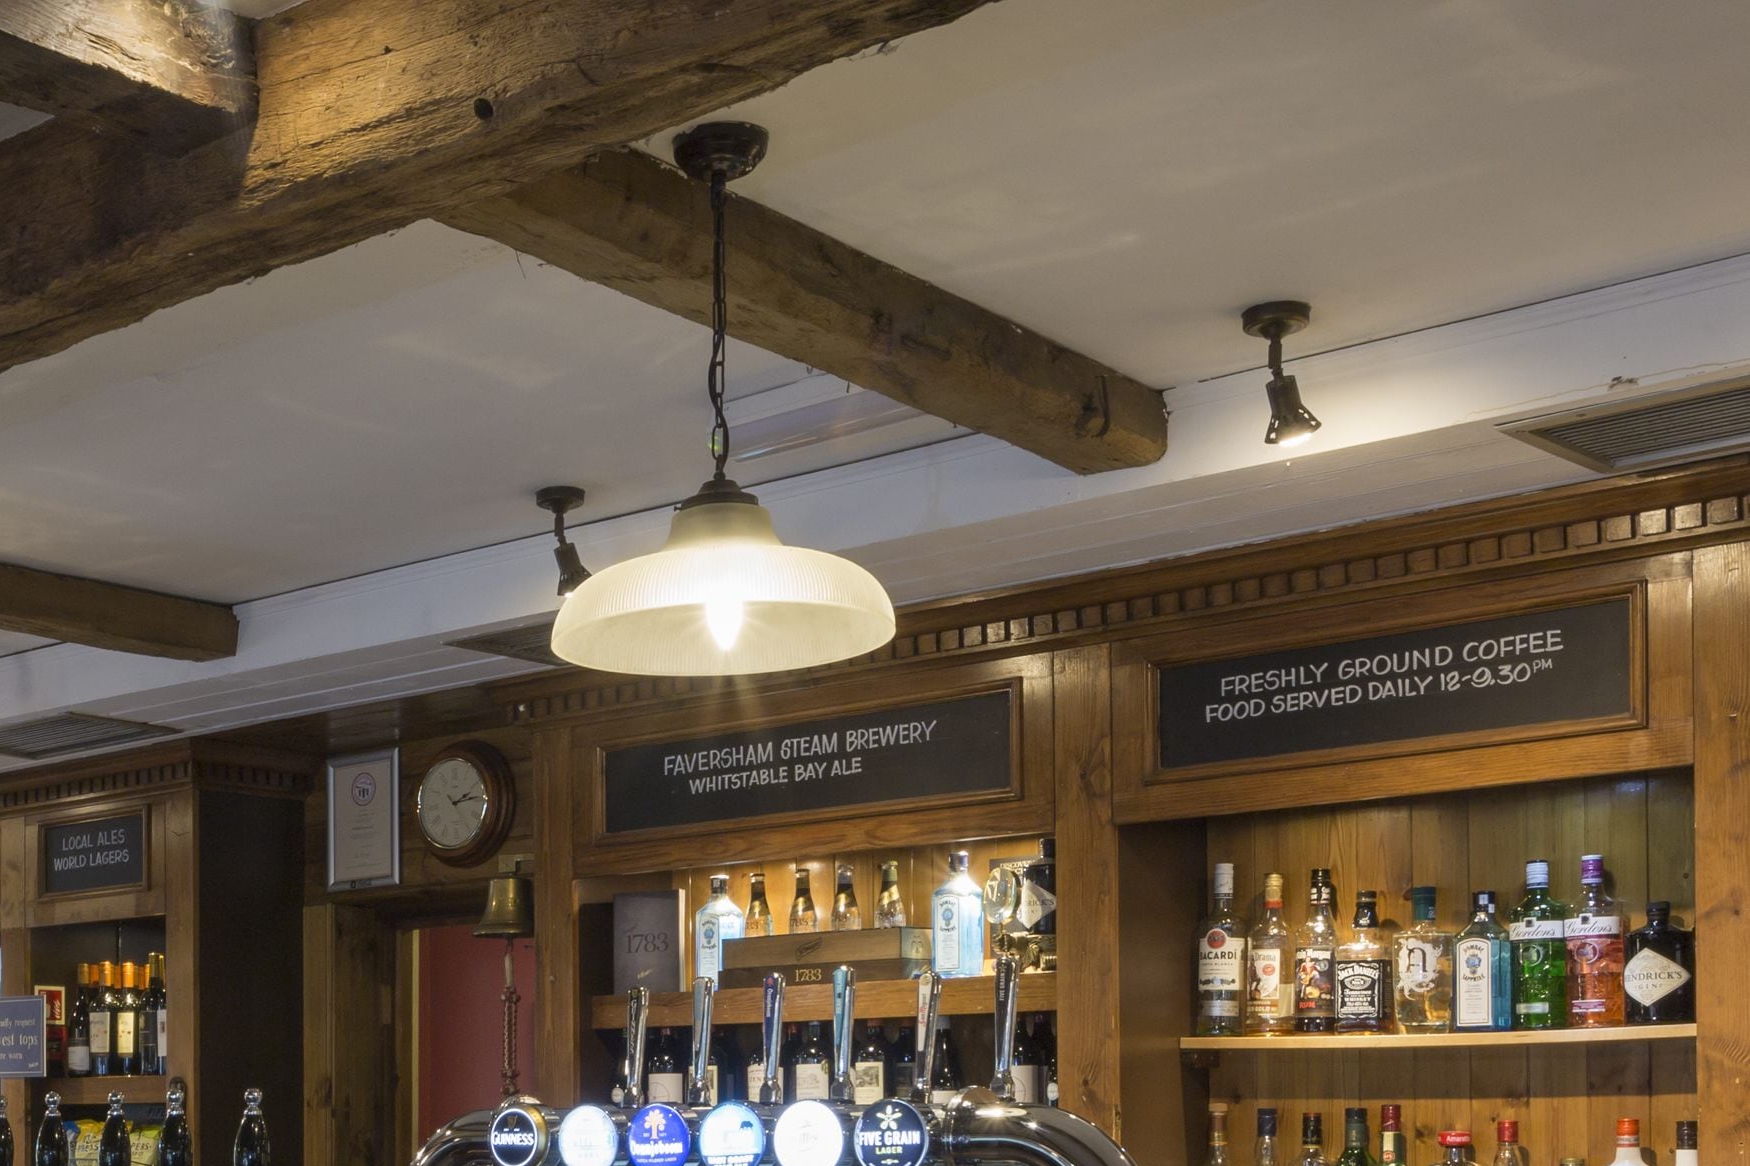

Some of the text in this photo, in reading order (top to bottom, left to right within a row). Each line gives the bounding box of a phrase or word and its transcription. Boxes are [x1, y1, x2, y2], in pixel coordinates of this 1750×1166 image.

[1220, 629, 1564, 696] FRESHLY GROUND COFFEE
[1205, 699, 1266, 723] FOOD
[1270, 683, 1362, 713] SERVED
[1367, 675, 1433, 701] DAILY
[664, 719, 937, 776] FAVERSHAM STEAM BREWERY
[688, 757, 862, 795] WHITSTABLE BAY ALE
[61, 829, 126, 851] LOCAL ALES
[53, 848, 130, 872] WORLD LAGERS
[1510, 925, 1556, 939] Gordon's
[1565, 918, 1613, 935] Gordon's
[624, 931, 670, 954] 1783
[794, 968, 822, 982] 1783
[19, 1033, 39, 1050] tops
[492, 1131, 535, 1146] GUINNESS
[859, 1130, 921, 1146] FIVE GRAIN
[875, 1146, 903, 1155] LAGER
